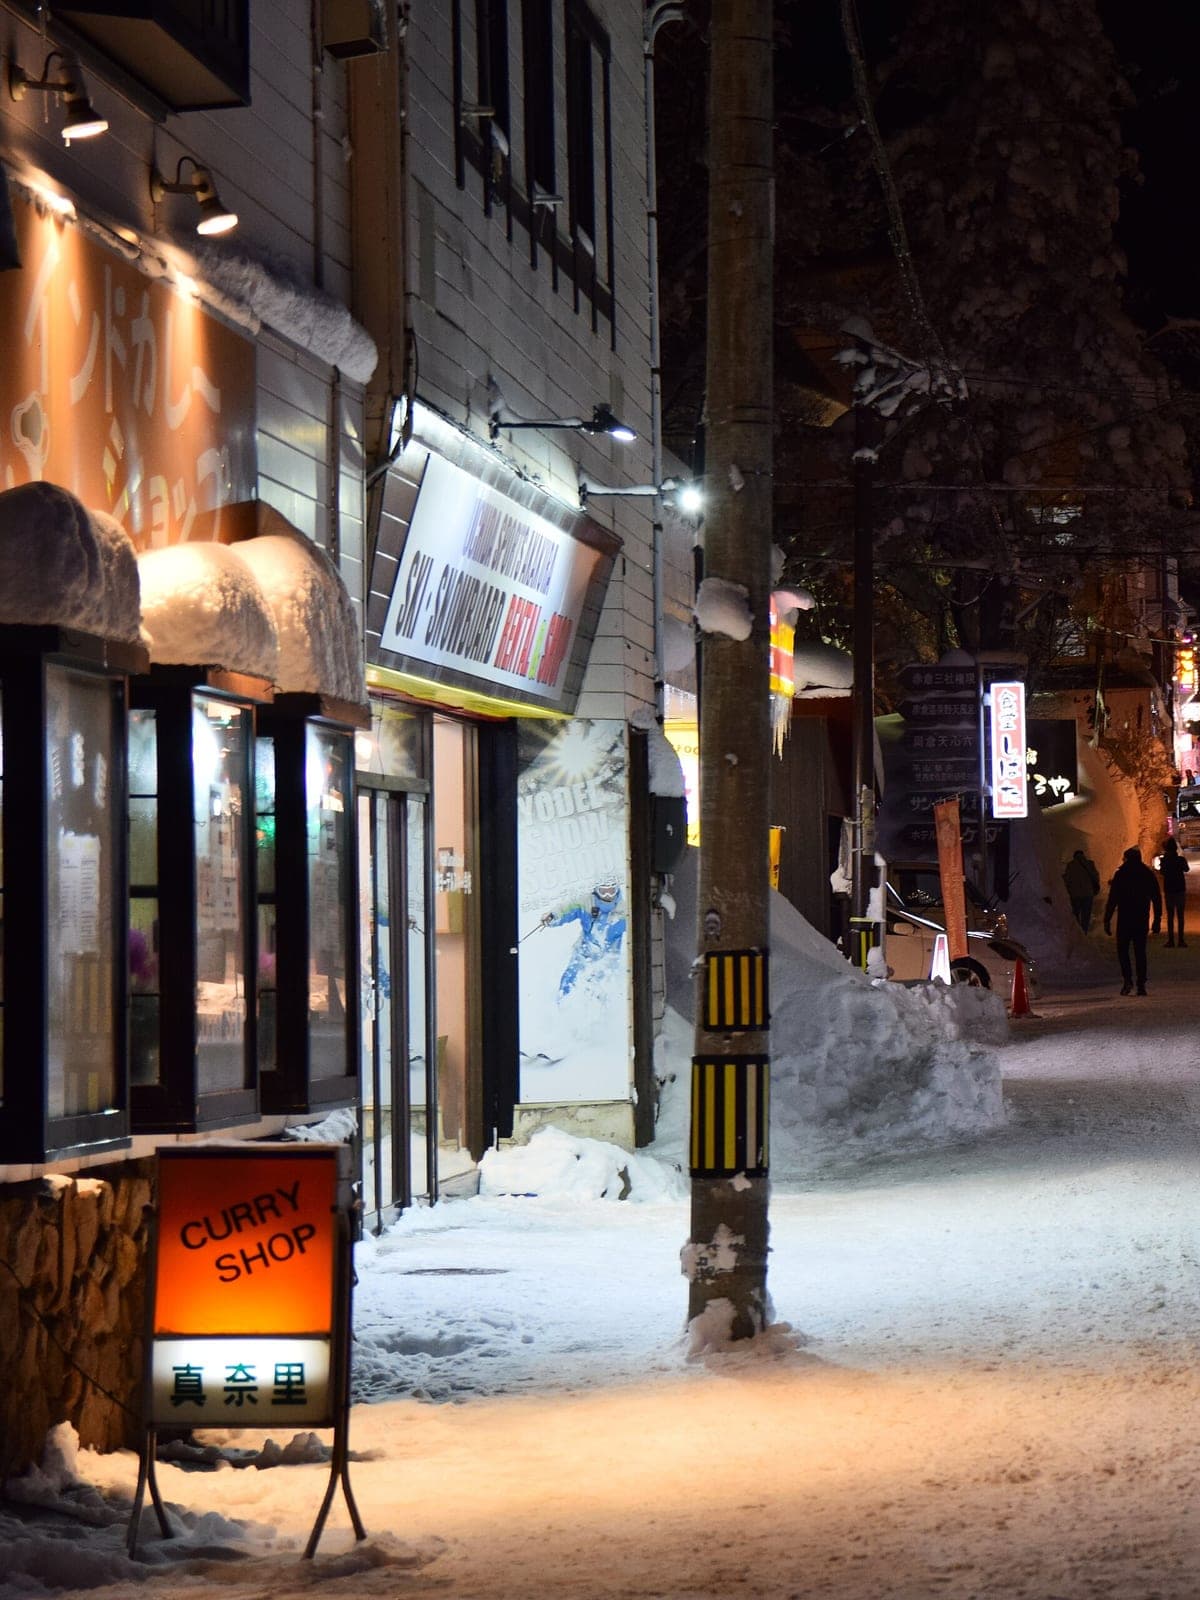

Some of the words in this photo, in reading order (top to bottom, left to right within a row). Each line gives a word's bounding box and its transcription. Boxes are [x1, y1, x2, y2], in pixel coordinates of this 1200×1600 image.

[395, 550, 434, 640] SKI
[425, 563, 507, 665] SNOWBOARD
[493, 593, 542, 678] RENTAL
[180, 1180, 300, 1250] CURRY
[215, 1223, 316, 1283] SHOP
[170, 1363, 308, 1407] 真奈里
